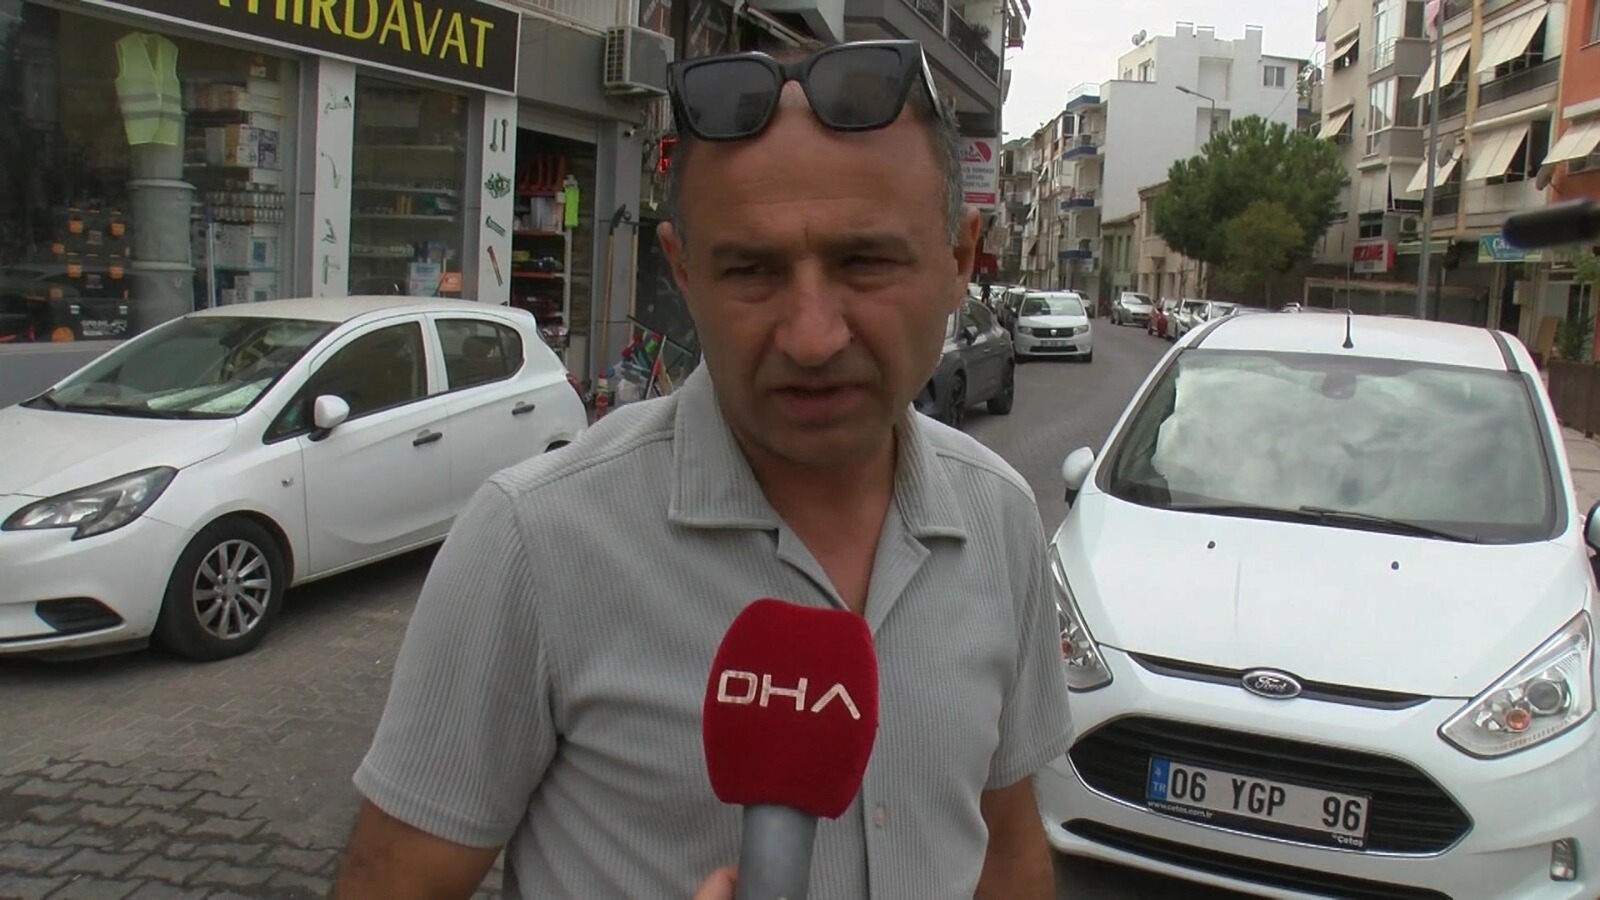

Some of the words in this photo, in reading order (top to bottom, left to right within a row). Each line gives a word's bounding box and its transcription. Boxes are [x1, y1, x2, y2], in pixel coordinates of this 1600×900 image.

[717, 669, 861, 720] DHA
[1255, 676, 1287, 692] Ford
[1152, 781, 1166, 793] TR
[1170, 768, 1207, 802] 06
[1230, 777, 1286, 817] YGP
[1322, 796, 1362, 832] 96
